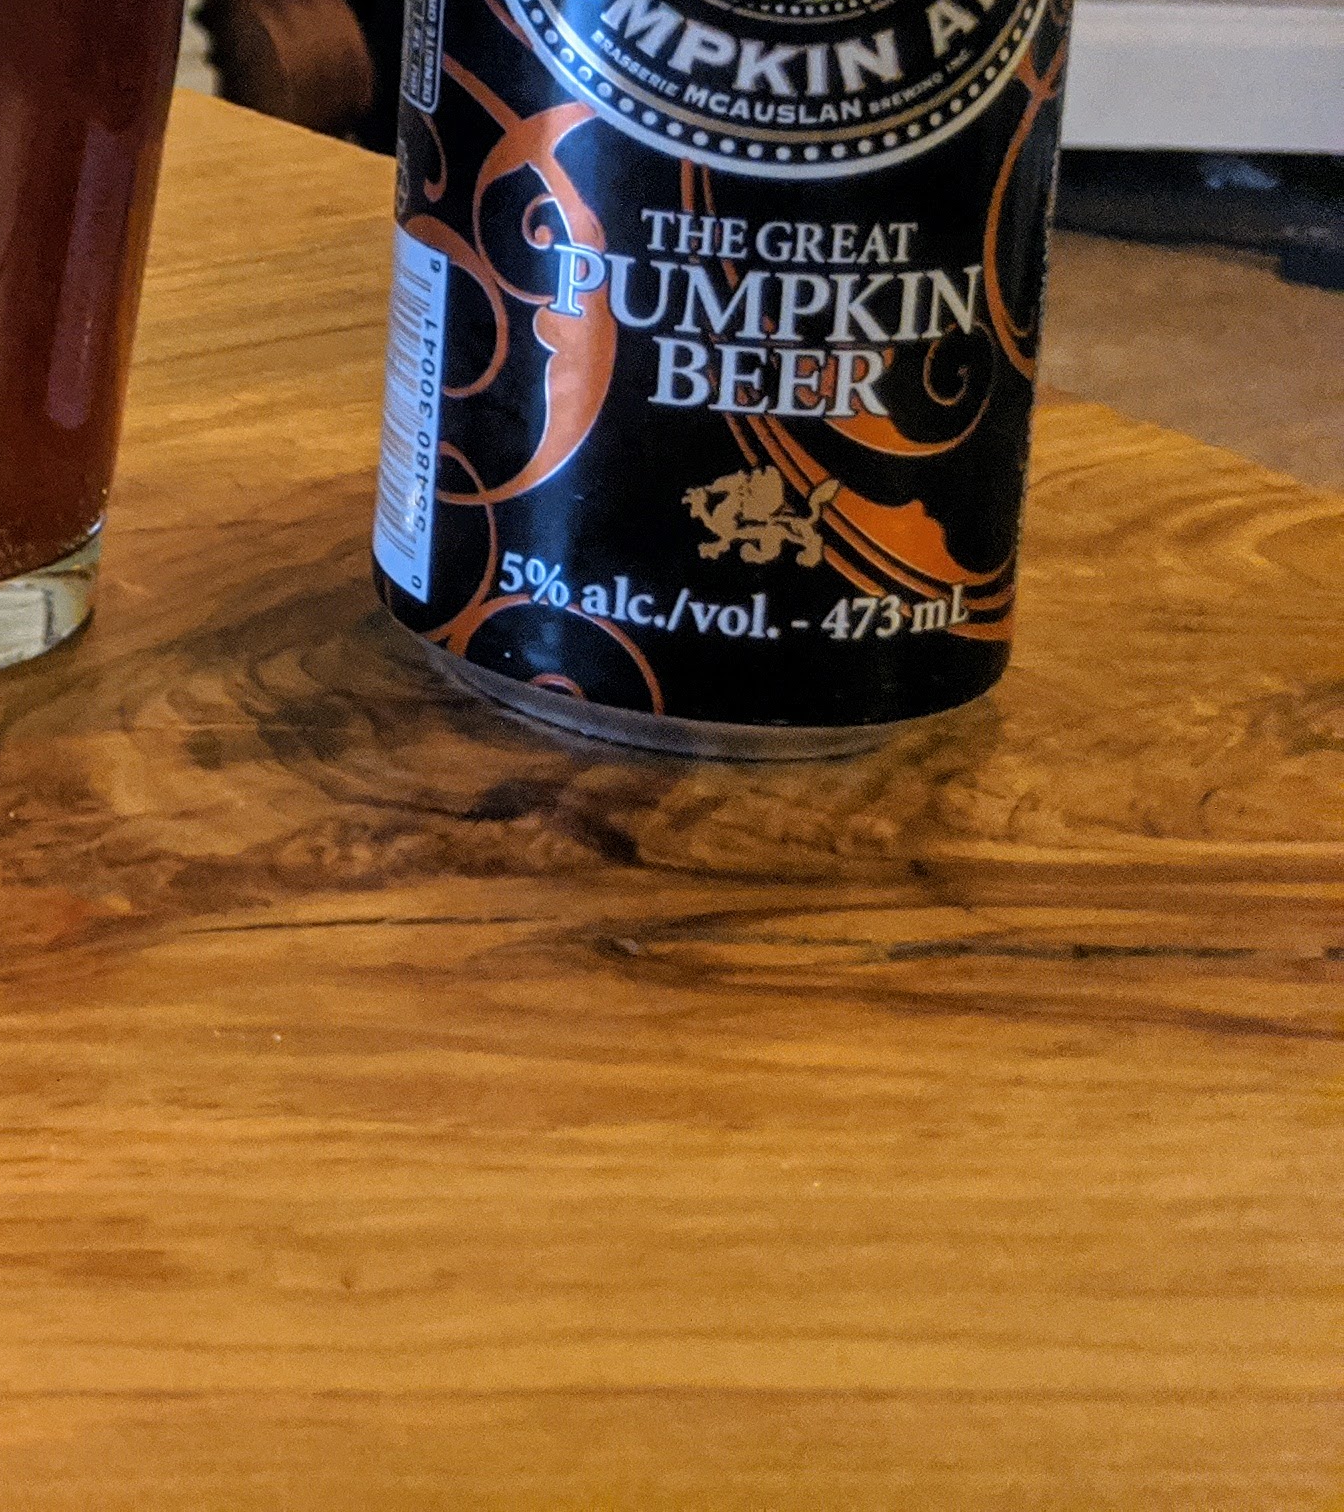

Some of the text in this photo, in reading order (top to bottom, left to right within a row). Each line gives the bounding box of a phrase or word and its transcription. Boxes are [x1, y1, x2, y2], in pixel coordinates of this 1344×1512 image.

[591, 30, 679, 98] BRASSERIE
[640, 208, 919, 265] THE GREAT
[548, 242, 983, 346] PUMPKIN
[419, 318, 438, 419] 30041
[647, 334, 889, 418] BEER
[414, 435, 432, 534] 55480
[499, 550, 569, 608] 5%
[580, 574, 780, 640] alc./vol.
[820, 594, 903, 640] 473
[911, 583, 969, 633] mL
